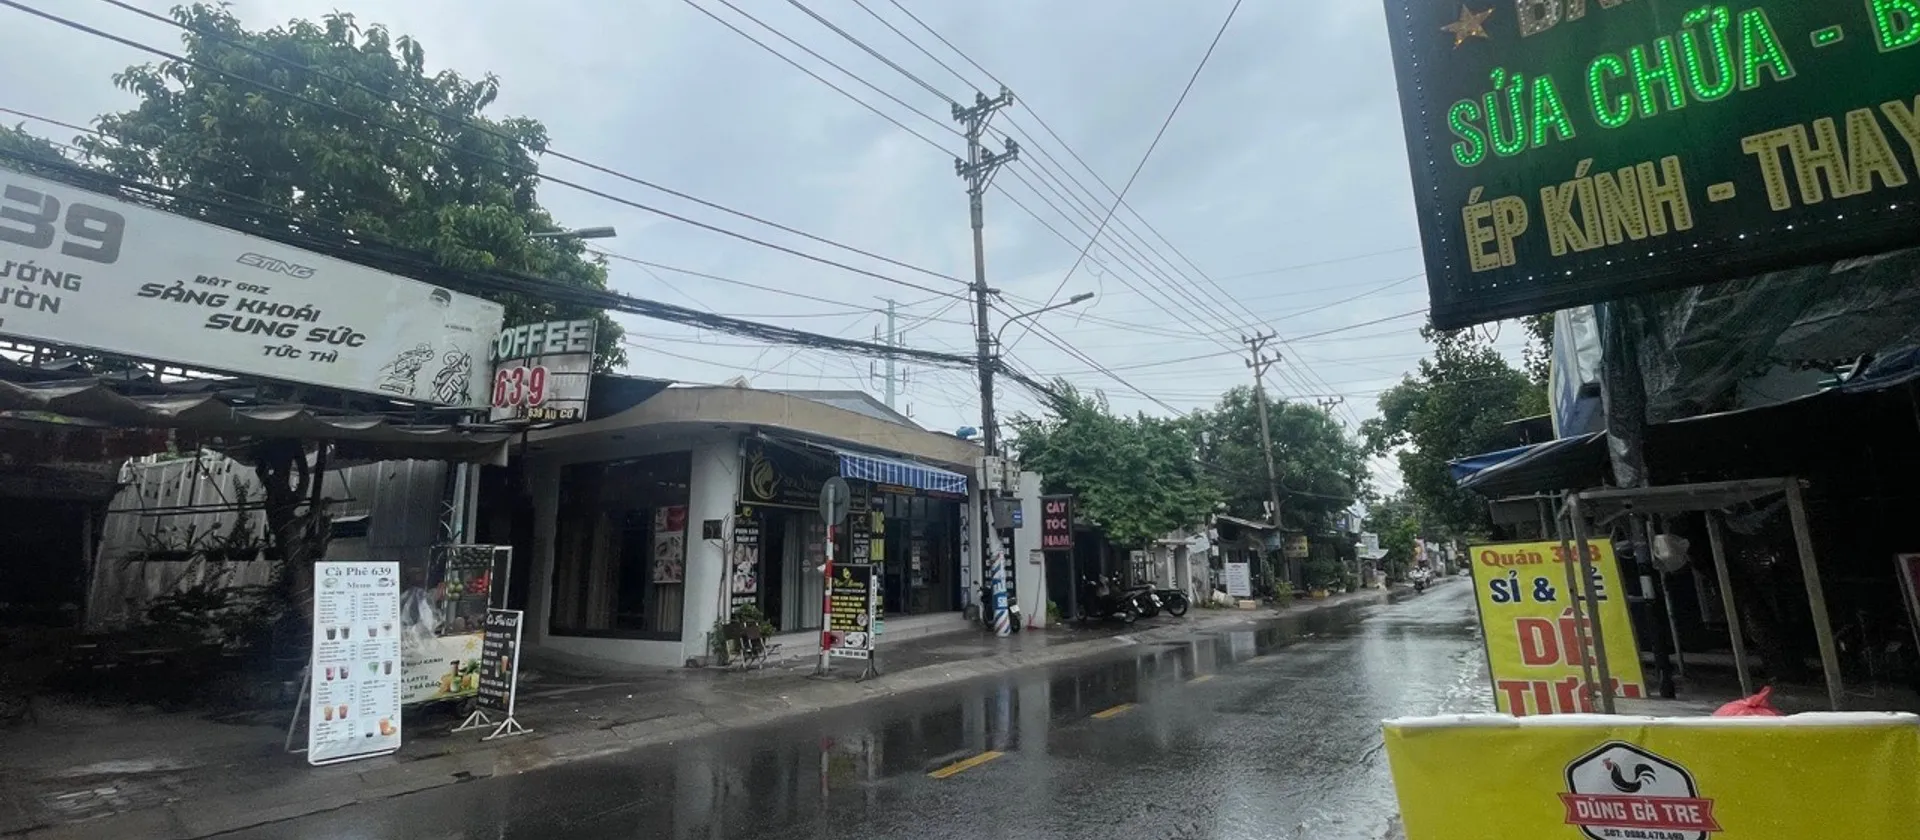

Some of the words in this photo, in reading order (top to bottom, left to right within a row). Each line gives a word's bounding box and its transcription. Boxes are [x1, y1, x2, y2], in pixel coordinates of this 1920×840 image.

[1447, 66, 1575, 167] SỬA
[1585, 5, 1796, 128] CHỮA
[1461, 186, 1528, 272] ÉP
[1540, 158, 1693, 257] KÍNH
[236, 252, 317, 279] STING
[137, 280, 229, 308] SẢNG
[235, 297, 321, 322] KHOÁI
[236, 282, 271, 295] GAZ
[205, 313, 299, 339] SUNG
[305, 325, 366, 348] SỨC
[488, 320, 589, 361] COFFEE
[263, 344, 302, 359] TỨC
[308, 349, 339, 363] THÌ
[494, 366, 546, 407] 639
[1044, 535, 1071, 547] NAM
[325, 567, 342, 576] Cà
[346, 567, 368, 576] Phê
[371, 567, 391, 576] 639
[1480, 549, 1543, 568] Quán
[1489, 570, 1521, 603] SỈ
[1533, 577, 1556, 602] &
[1516, 607, 1597, 667] DÊ
[1497, 676, 1641, 717] TƯƠ
[1576, 797, 1627, 821] DŨNG
[1632, 800, 1659, 823] GÀ
[1661, 804, 1703, 825] TRE
